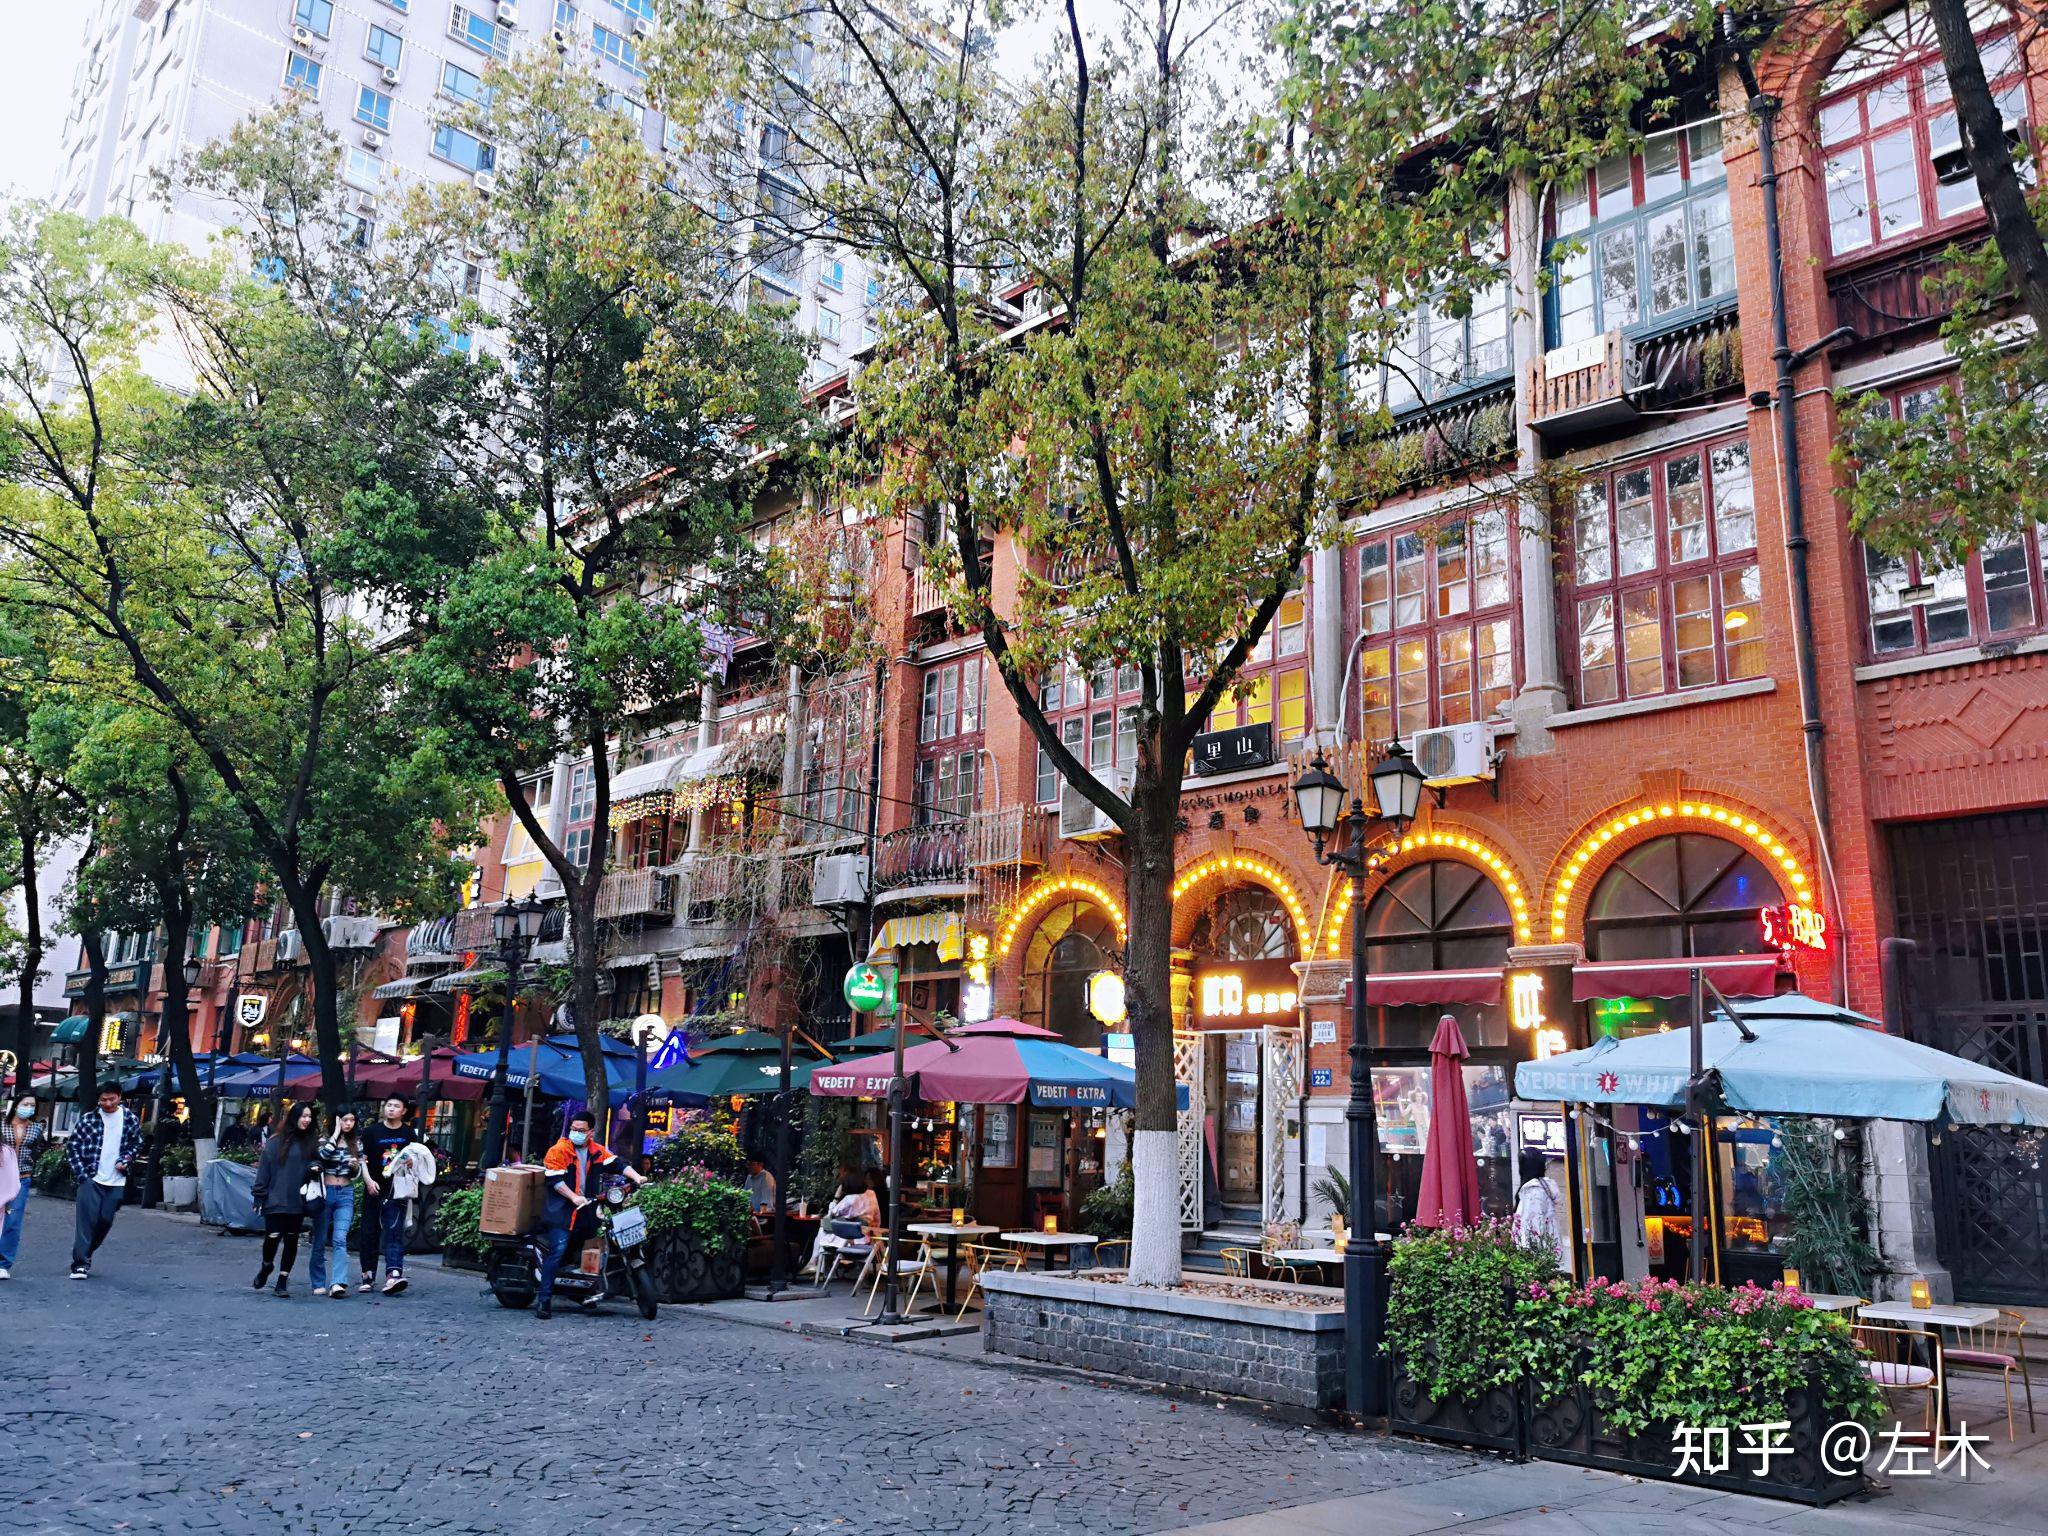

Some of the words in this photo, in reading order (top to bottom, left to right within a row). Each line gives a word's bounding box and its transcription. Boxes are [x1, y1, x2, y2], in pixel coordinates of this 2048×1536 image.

[1206, 736, 1254, 761] 里山
[460, 1063, 489, 1077] VEDETT
[818, 1076, 856, 1089] VEDETT
[866, 1077, 889, 1090] EXT
[1315, 1075, 1326, 1084] 22
[1519, 1069, 1592, 1091] VEDETT
[1624, 1073, 1687, 1093] WHIT
[1036, 1085, 1067, 1099] VEDETT
[1076, 1086, 1106, 1100] EXTRA
